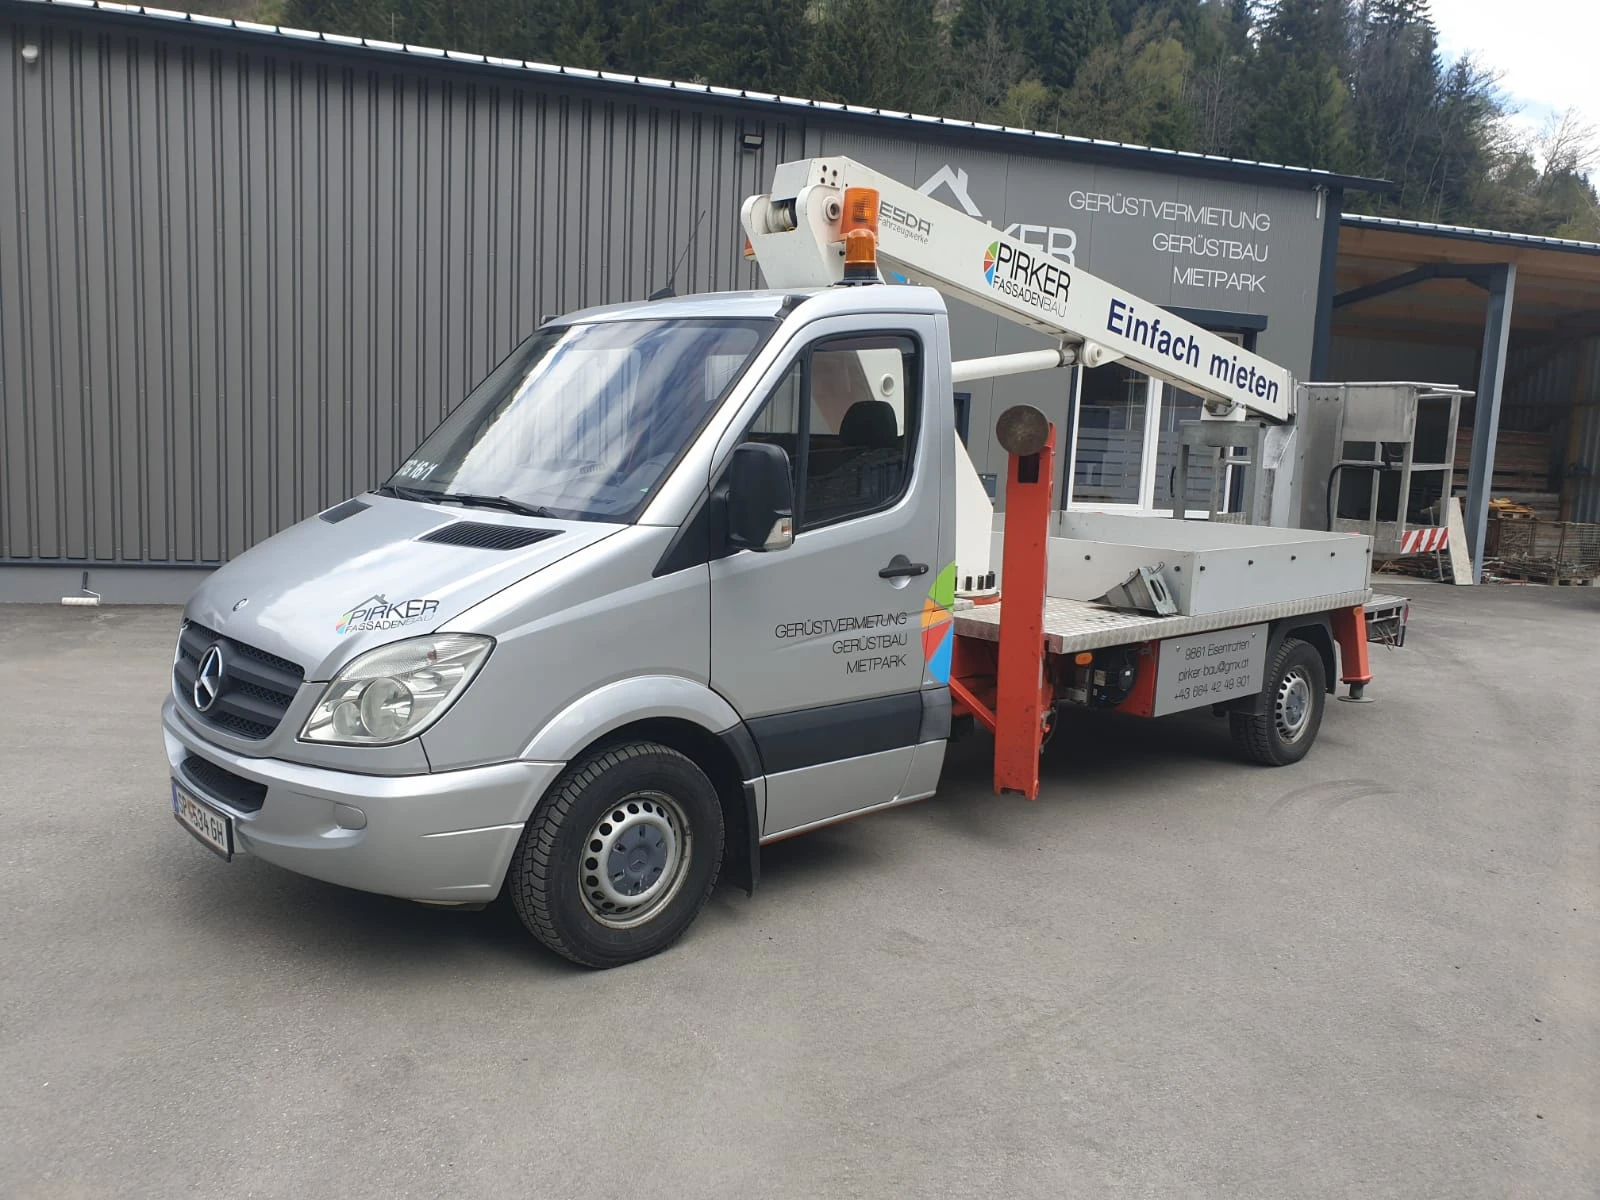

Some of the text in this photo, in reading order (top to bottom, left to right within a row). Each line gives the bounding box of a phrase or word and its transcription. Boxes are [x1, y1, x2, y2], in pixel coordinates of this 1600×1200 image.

[879, 200, 931, 236] ESDA
[1068, 190, 1271, 232] GERÜSTVERMIETUNG
[1152, 232, 1269, 263] GERÜSTBAU
[995, 242, 1071, 303] PIRKER
[1173, 266, 1267, 293] MIETPARK
[992, 274, 1067, 318] FASSADENBAU
[1106, 298, 1279, 404] Einfach mieten
[344, 611, 435, 634] FASSADENBAU
[347, 599, 440, 625] PIRKER
[775, 611, 908, 639] GERÜSTVERMIETUNG
[832, 631, 908, 655] GERÜSTBAU
[846, 653, 907, 675] MIETPARK
